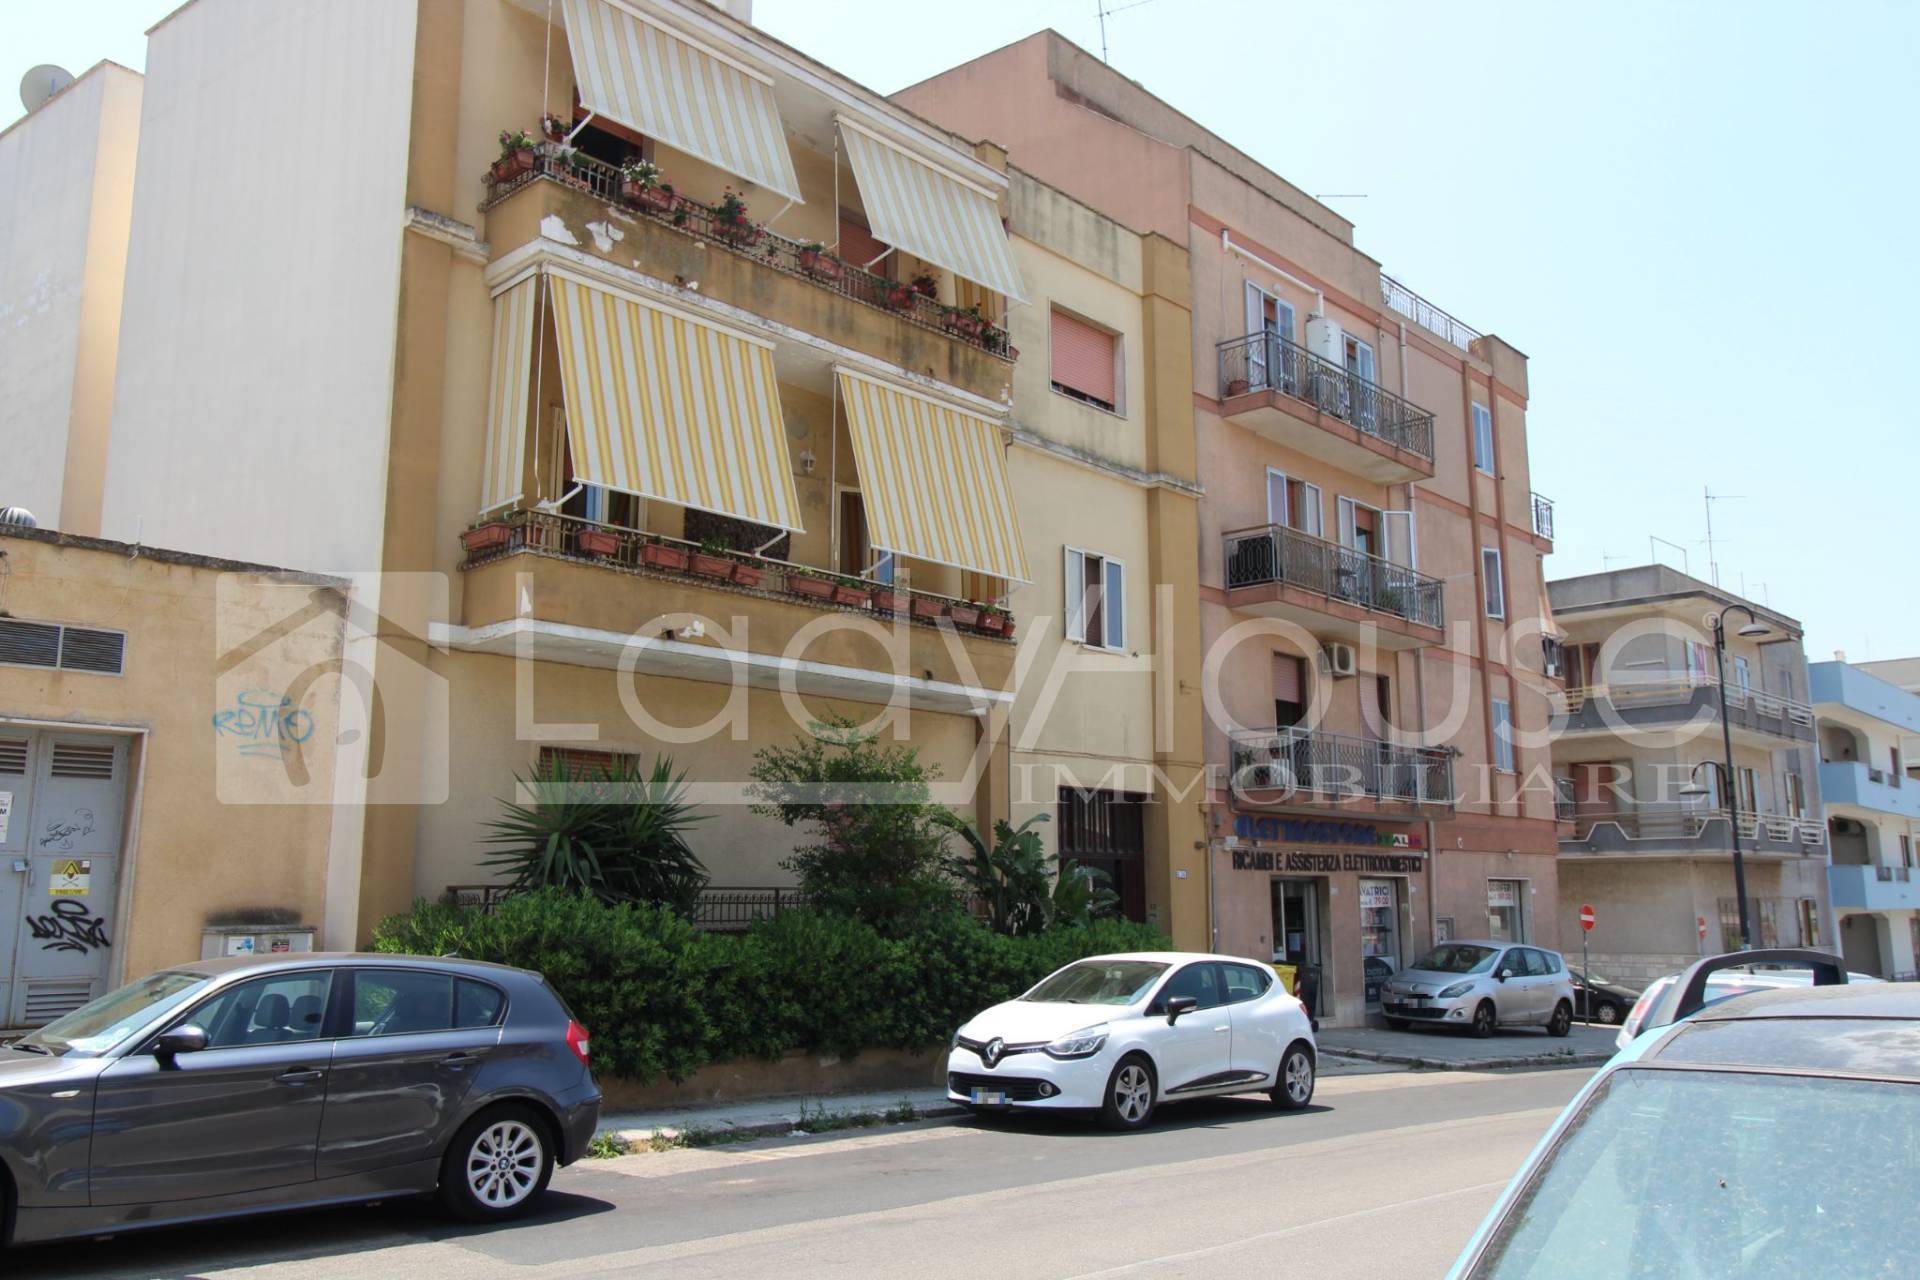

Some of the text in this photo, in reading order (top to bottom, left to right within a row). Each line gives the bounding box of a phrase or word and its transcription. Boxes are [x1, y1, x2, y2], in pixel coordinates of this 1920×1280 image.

[1232, 852, 1422, 872] RICAMBI E ASSISTENZA ELETTRODOMESTICI
[1360, 886, 1389, 896] VATRICI
